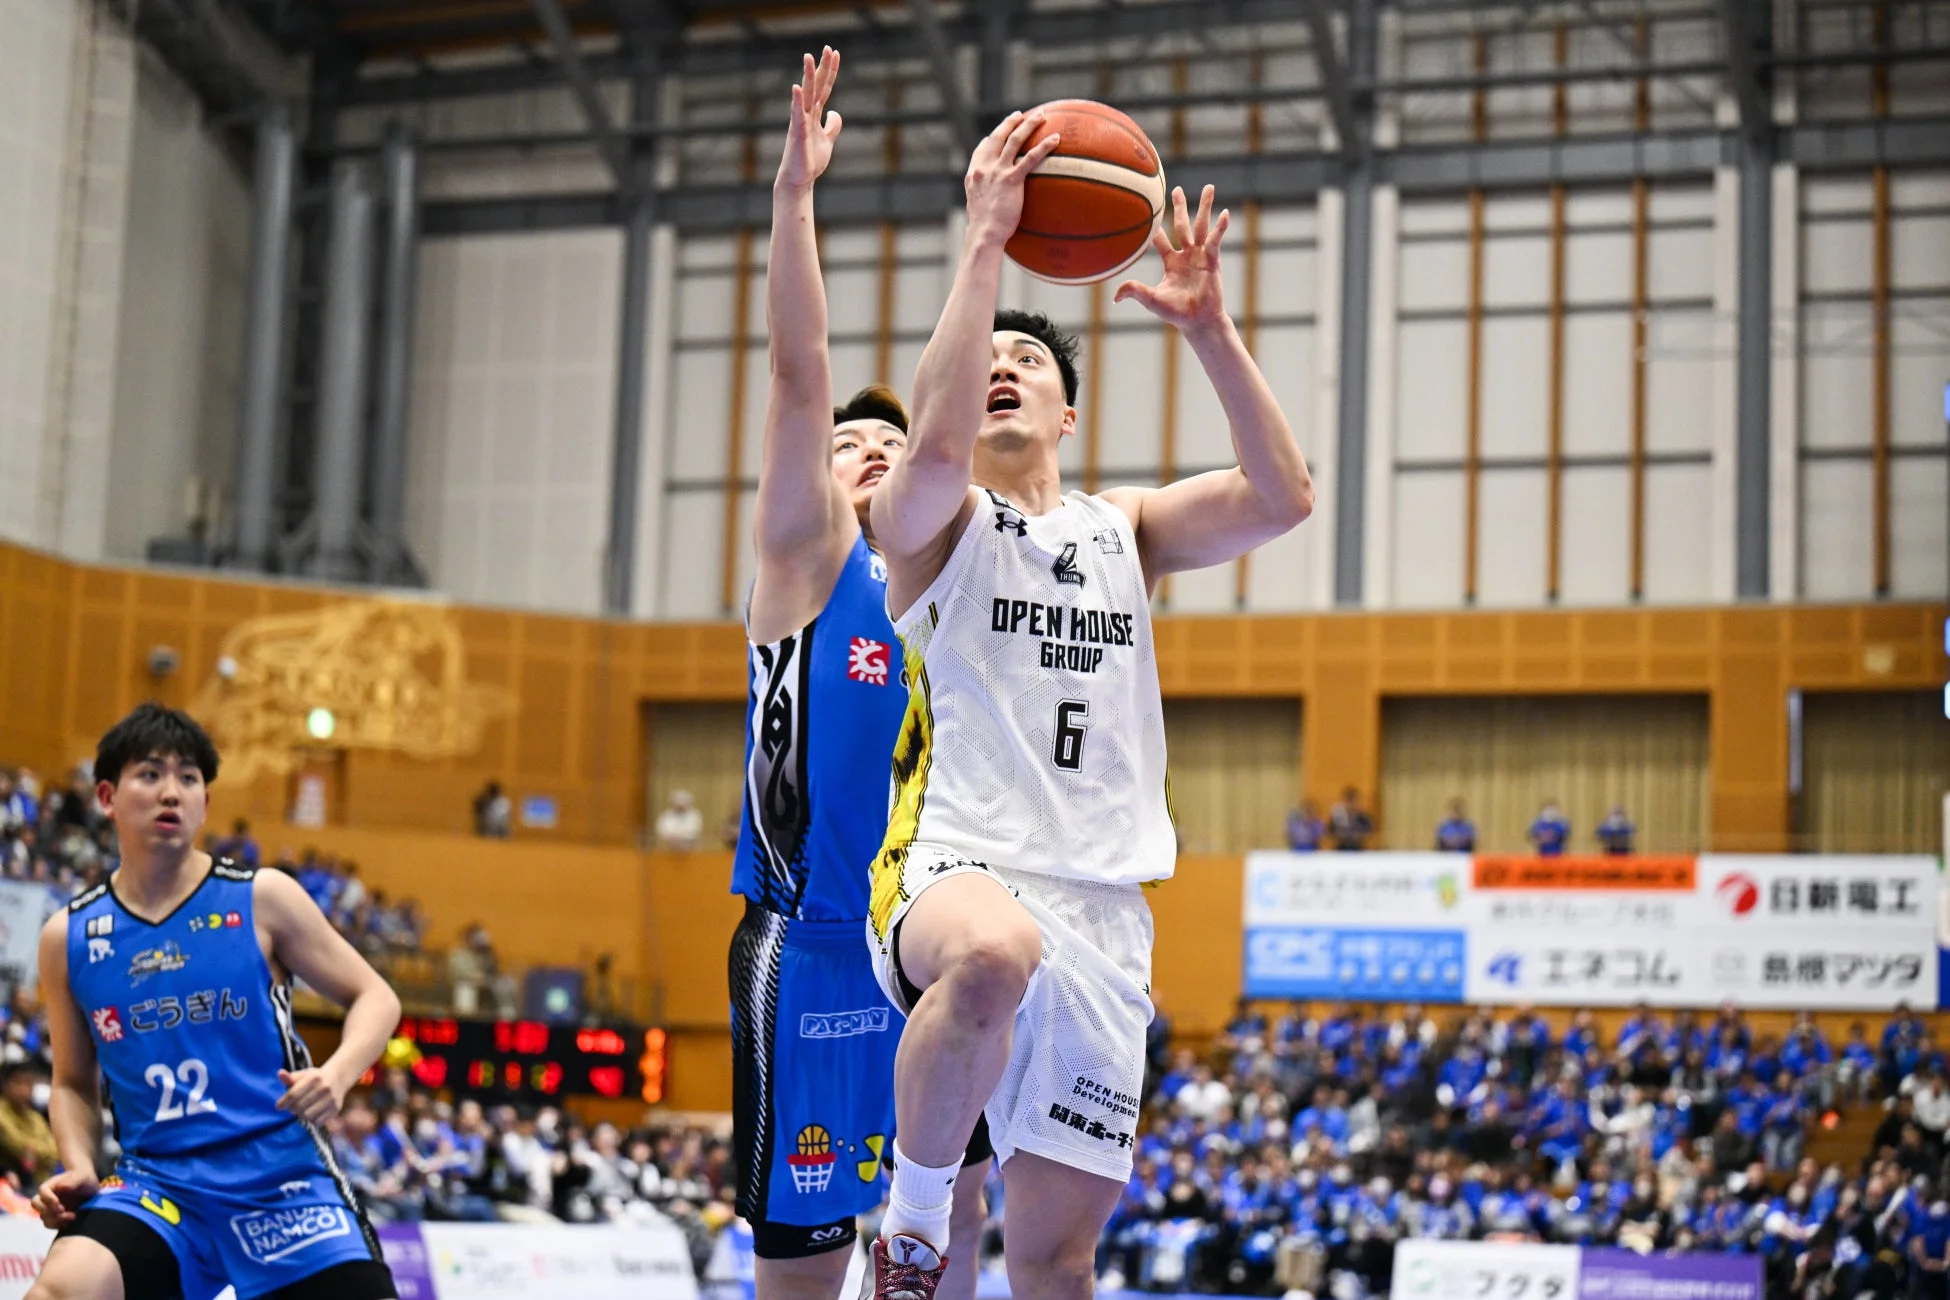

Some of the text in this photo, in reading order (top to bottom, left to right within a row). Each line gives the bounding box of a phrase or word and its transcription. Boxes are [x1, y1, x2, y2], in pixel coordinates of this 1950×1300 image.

[991, 598, 1134, 646] OPEN HOUSE
[1040, 641, 1103, 673] GROUP
[1051, 698, 1089, 773] 6
[1770, 877, 1918, 914] 日新電工
[1543, 950, 1682, 987] エネコム
[129, 987, 248, 1032] ごうぎん
[804, 1011, 887, 1035] PAC-MAN
[144, 1058, 217, 1122] 22
[1076, 1076, 1111, 1097] OPEN
[252, 1212, 337, 1254] NAMCO
